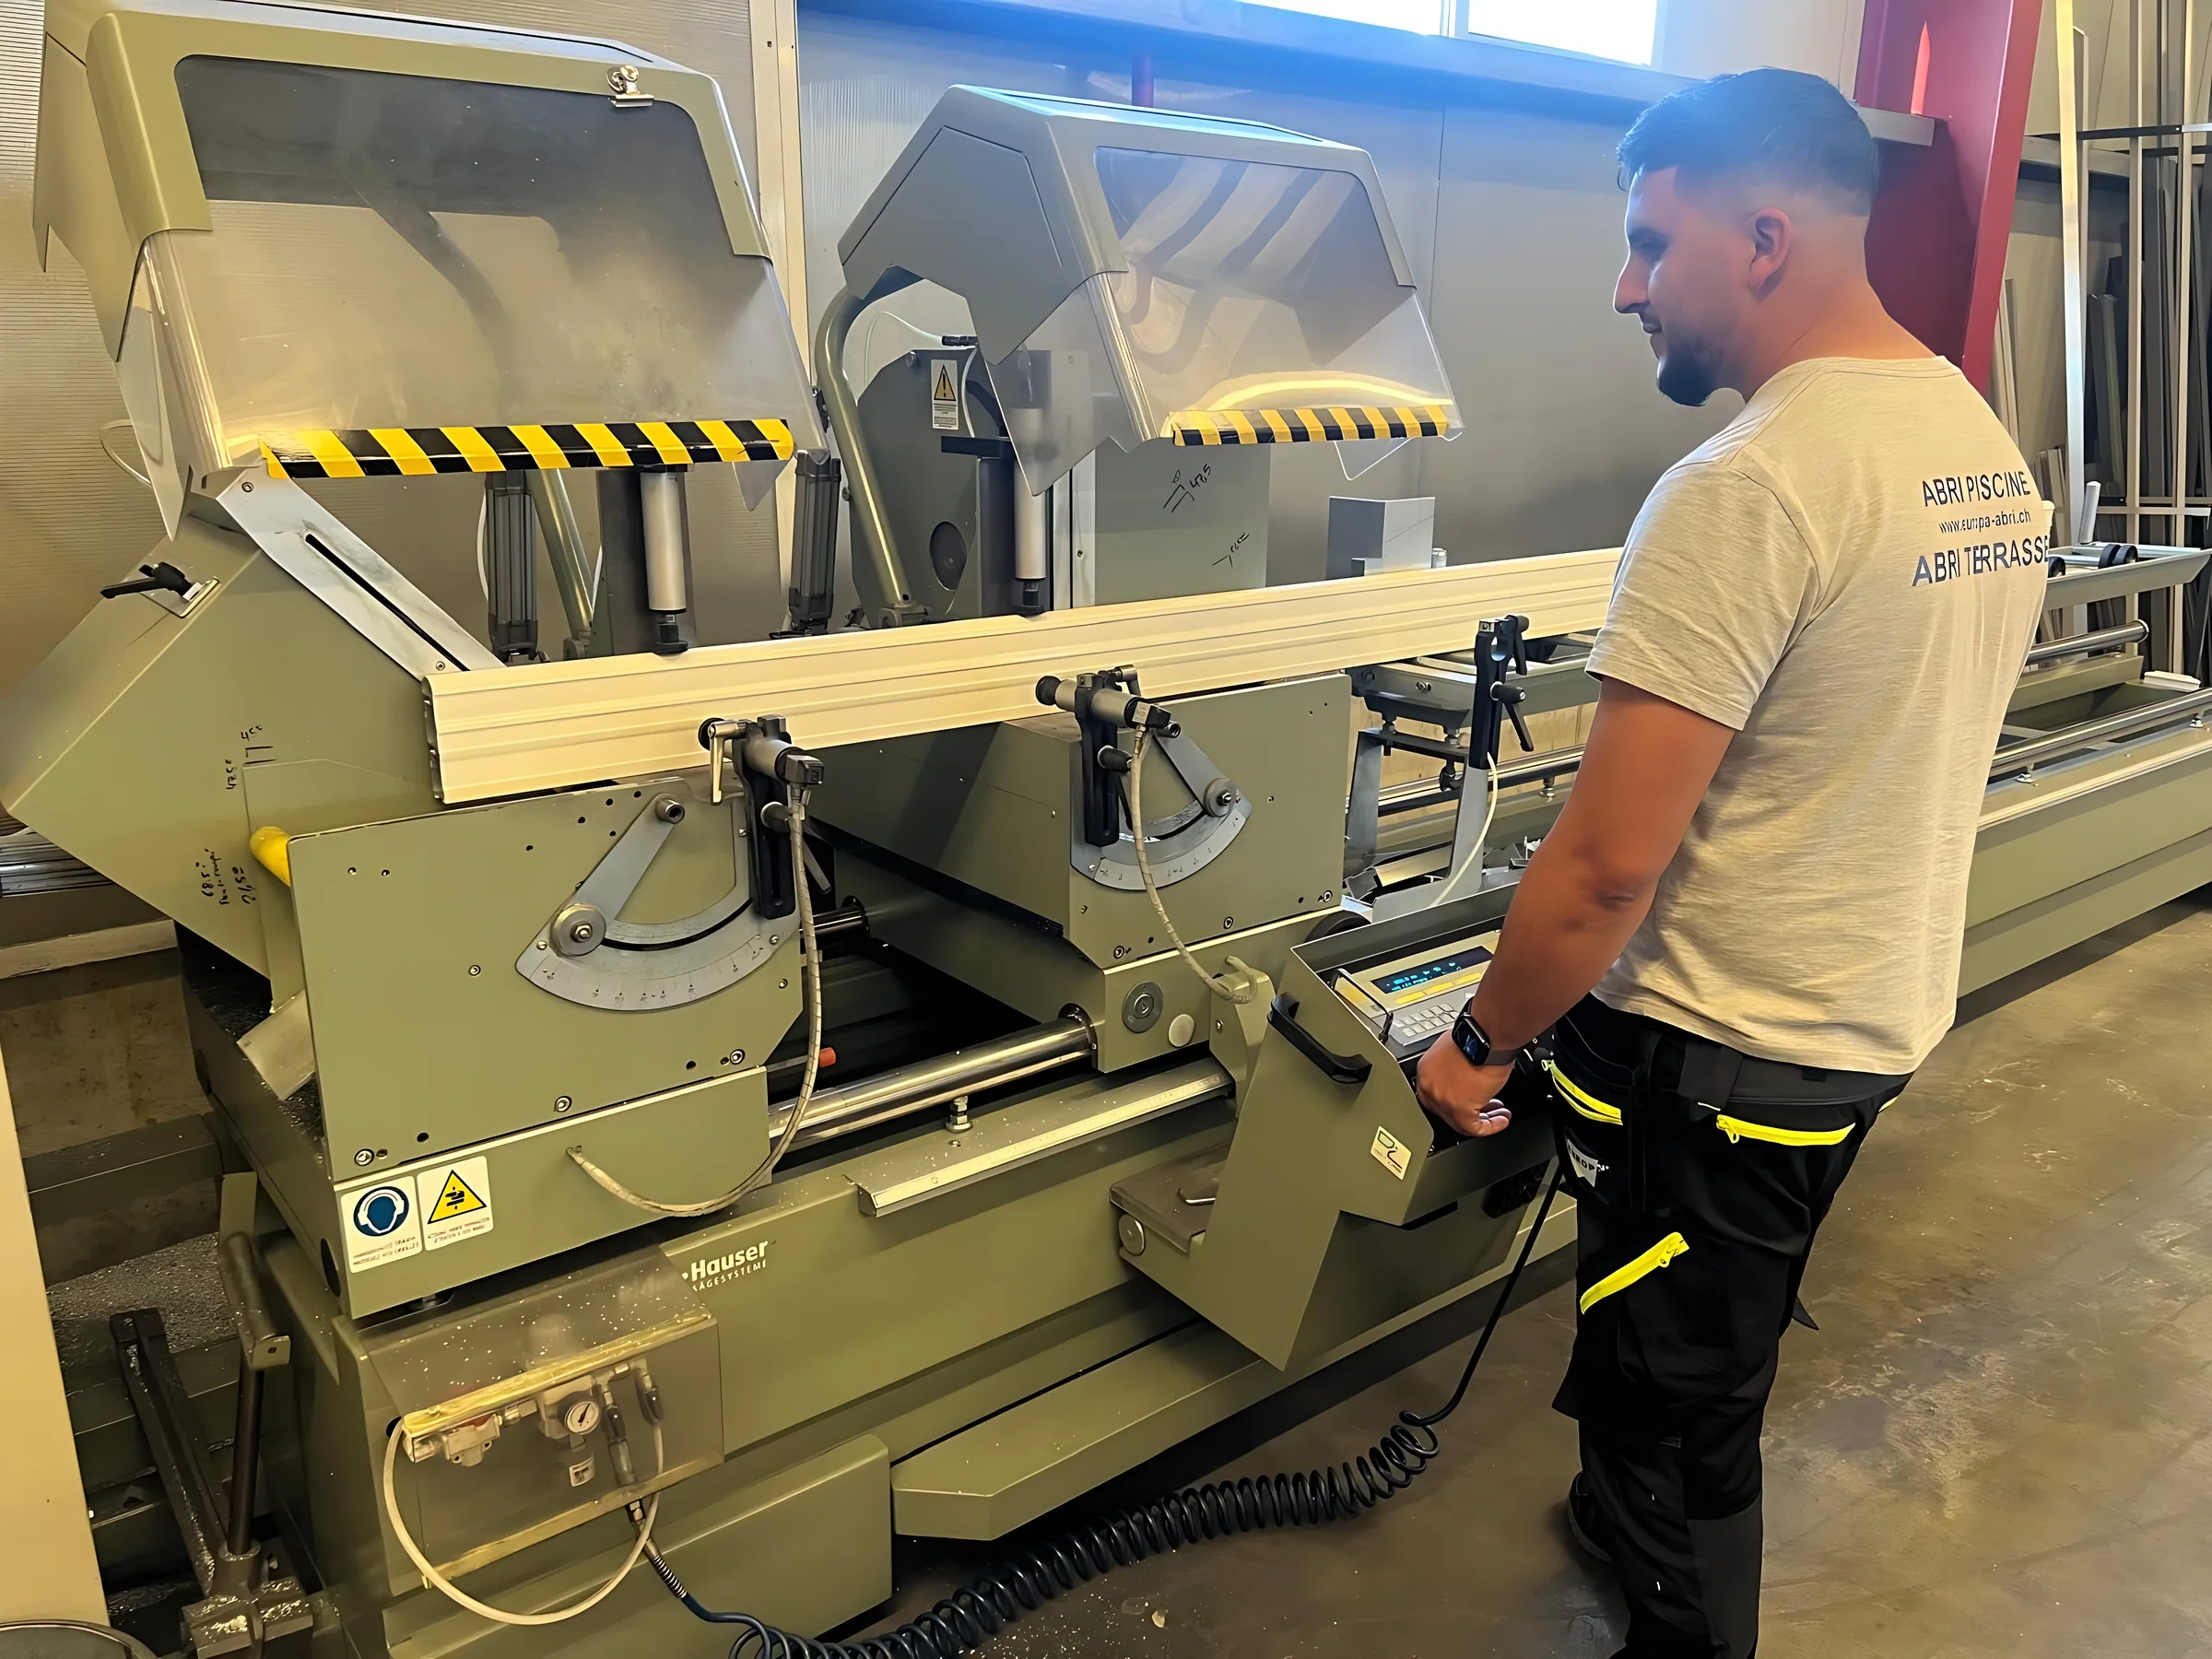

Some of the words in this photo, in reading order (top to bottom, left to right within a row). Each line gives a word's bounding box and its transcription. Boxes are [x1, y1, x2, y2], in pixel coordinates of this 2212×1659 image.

[1922, 476, 1965, 507] ABRI
[1966, 471, 2030, 502] PISCINE
[1912, 548, 1961, 587] ABRI
[691, 1241, 769, 1281] Hauser
